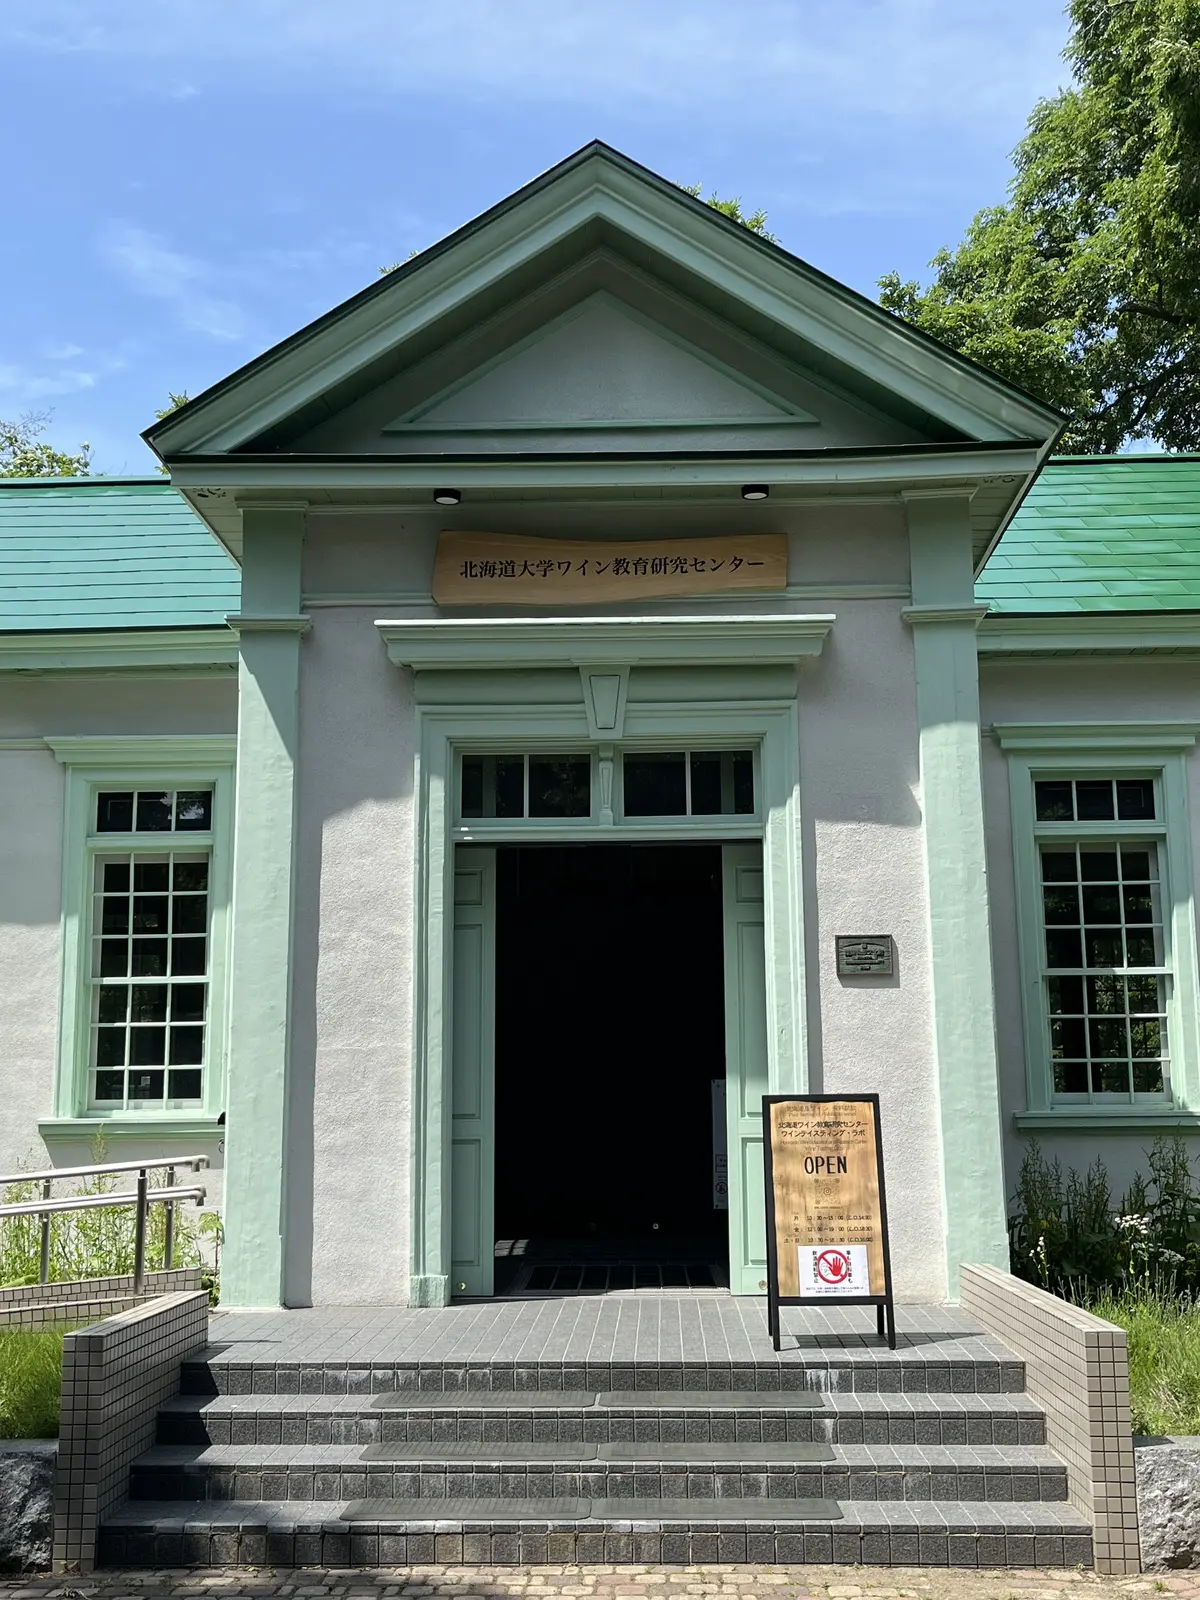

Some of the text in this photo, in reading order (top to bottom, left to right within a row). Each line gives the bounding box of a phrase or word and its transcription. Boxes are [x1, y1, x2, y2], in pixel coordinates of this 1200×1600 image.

[459, 556, 764, 579] 北海道大学ワイン教育研究センター
[804, 1156, 847, 1174] OPEN
